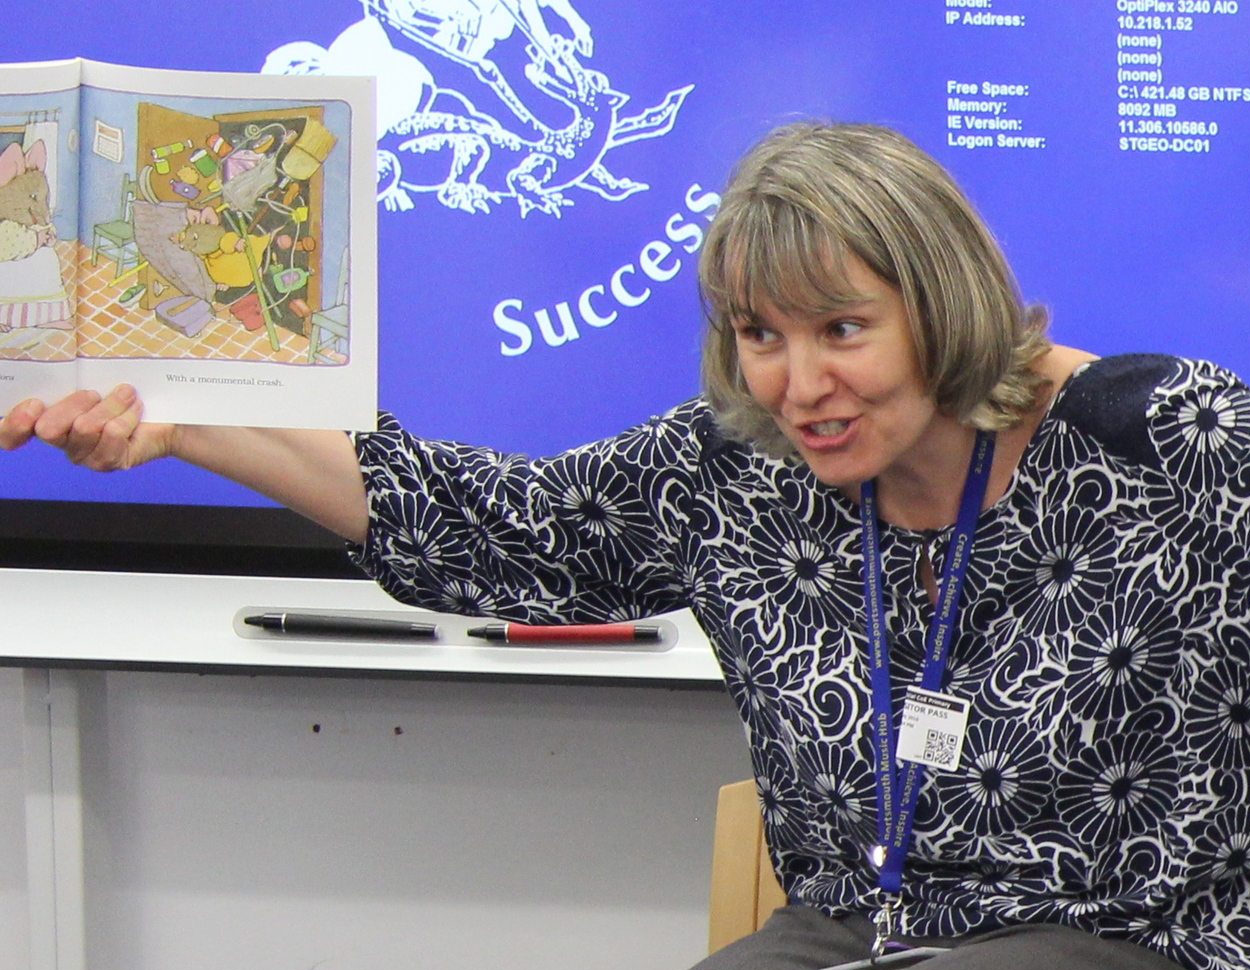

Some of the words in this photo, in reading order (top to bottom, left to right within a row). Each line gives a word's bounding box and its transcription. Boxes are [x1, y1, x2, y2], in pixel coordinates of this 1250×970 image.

[1116, 0, 1175, 14] OptiPlex
[1177, 0, 1212, 13] 3240
[1213, 0, 1239, 14] AIO
[945, 11, 961, 25] IP
[962, 11, 1026, 27] Address:
[1116, 15, 1194, 31] 10.218.1.52
[1116, 33, 1162, 50] (none)
[1116, 50, 1162, 67] (none)
[1116, 68, 1162, 85] (none)
[946, 80, 979, 95] Free
[981, 82, 1030, 98] Space:
[1141, 86, 1186, 101] 421.48
[1187, 87, 1211, 101] GB
[946, 98, 1008, 114] Memory:
[1117, 103, 1151, 117] 8092
[1153, 104, 1177, 118] MB
[947, 115, 963, 130] IE
[964, 116, 1023, 132] Version:
[1118, 120, 1219, 136] 11.306.10586.0
[947, 133, 994, 149] Logon
[996, 134, 1047, 149] Server:
[1119, 138, 1211, 153] STGEO-DC01
[492, 183, 722, 357] Success
[166, 374, 188, 383] With
[198, 376, 256, 386] monumental
[932, 623, 949, 661] Inspire
[927, 708, 949, 719] PASS
[878, 712, 888, 736] Hub
[880, 737, 890, 772] Music
